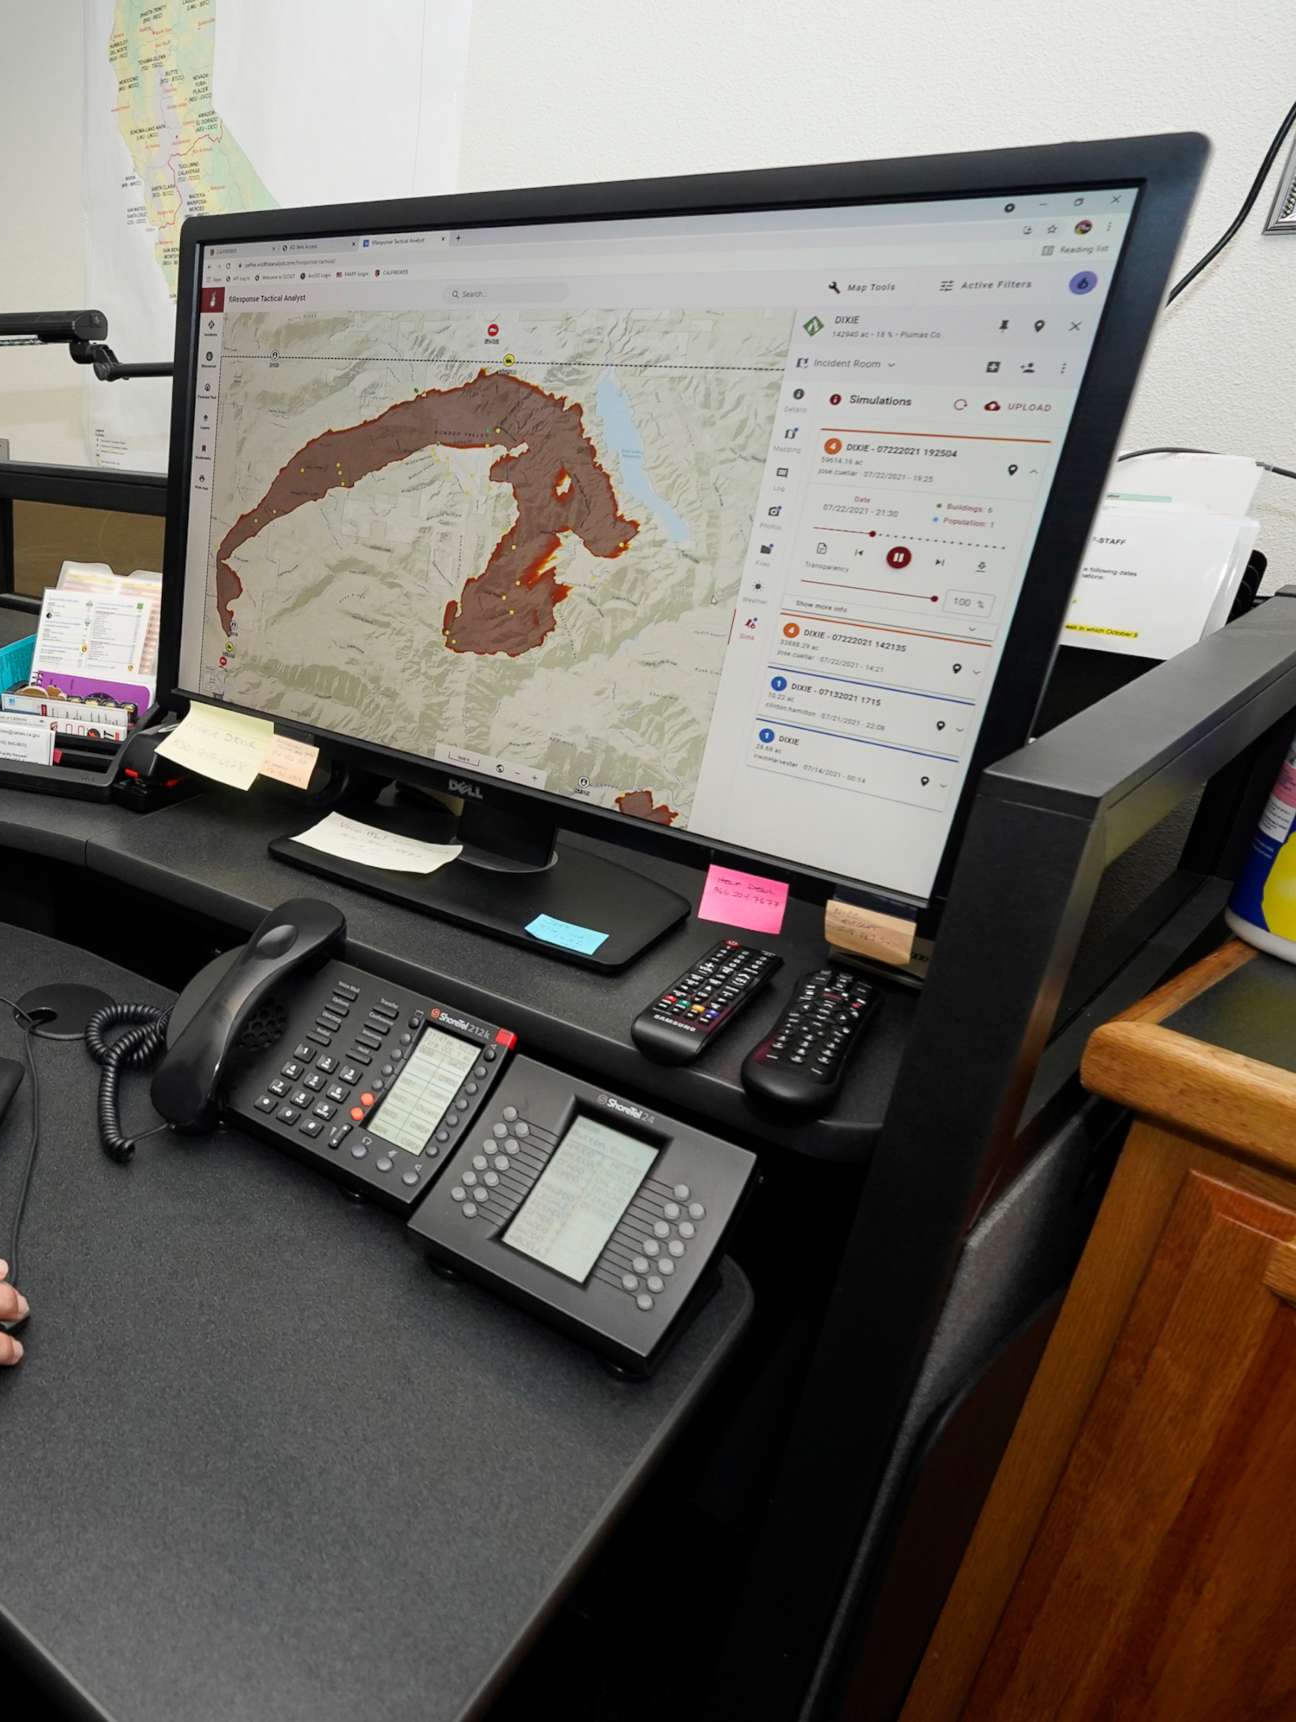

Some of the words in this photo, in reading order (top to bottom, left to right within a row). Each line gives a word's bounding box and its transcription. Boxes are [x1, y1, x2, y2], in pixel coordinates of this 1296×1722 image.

[1060, 244, 1094, 255] Reading
[1096, 243, 1109, 253] list
[847, 282, 865, 293] Map
[869, 280, 896, 292] Tools
[960, 279, 993, 291] Active
[995, 279, 1032, 290] Filters
[261, 294, 283, 302] Tactical
[284, 293, 306, 303] Analyst
[834, 315, 861, 325] DIXIE
[813, 358, 851, 369] Incident
[852, 359, 881, 369] Room
[849, 394, 912, 407] Simulations
[1007, 401, 1052, 413] UPLOAD
[846, 443, 871, 453] DIXIE
[854, 495, 871, 504] Date
[795, 599, 815, 608] Show
[953, 597, 972, 608] 100
[803, 628, 825, 640] DIXIE
[1085, 625, 1105, 634] which
[1105, 627, 1132, 638] October
[790, 682, 813, 693] DIXIE
[778, 735, 800, 746] DIXIE
[448, 779, 483, 800] DELL
[438, 1011, 469, 1032] ShoreTel
[467, 1023, 491, 1040] 212k
[653, 1013, 697, 1033] SAMSUNG
[606, 1098, 643, 1119] ShoreTel
